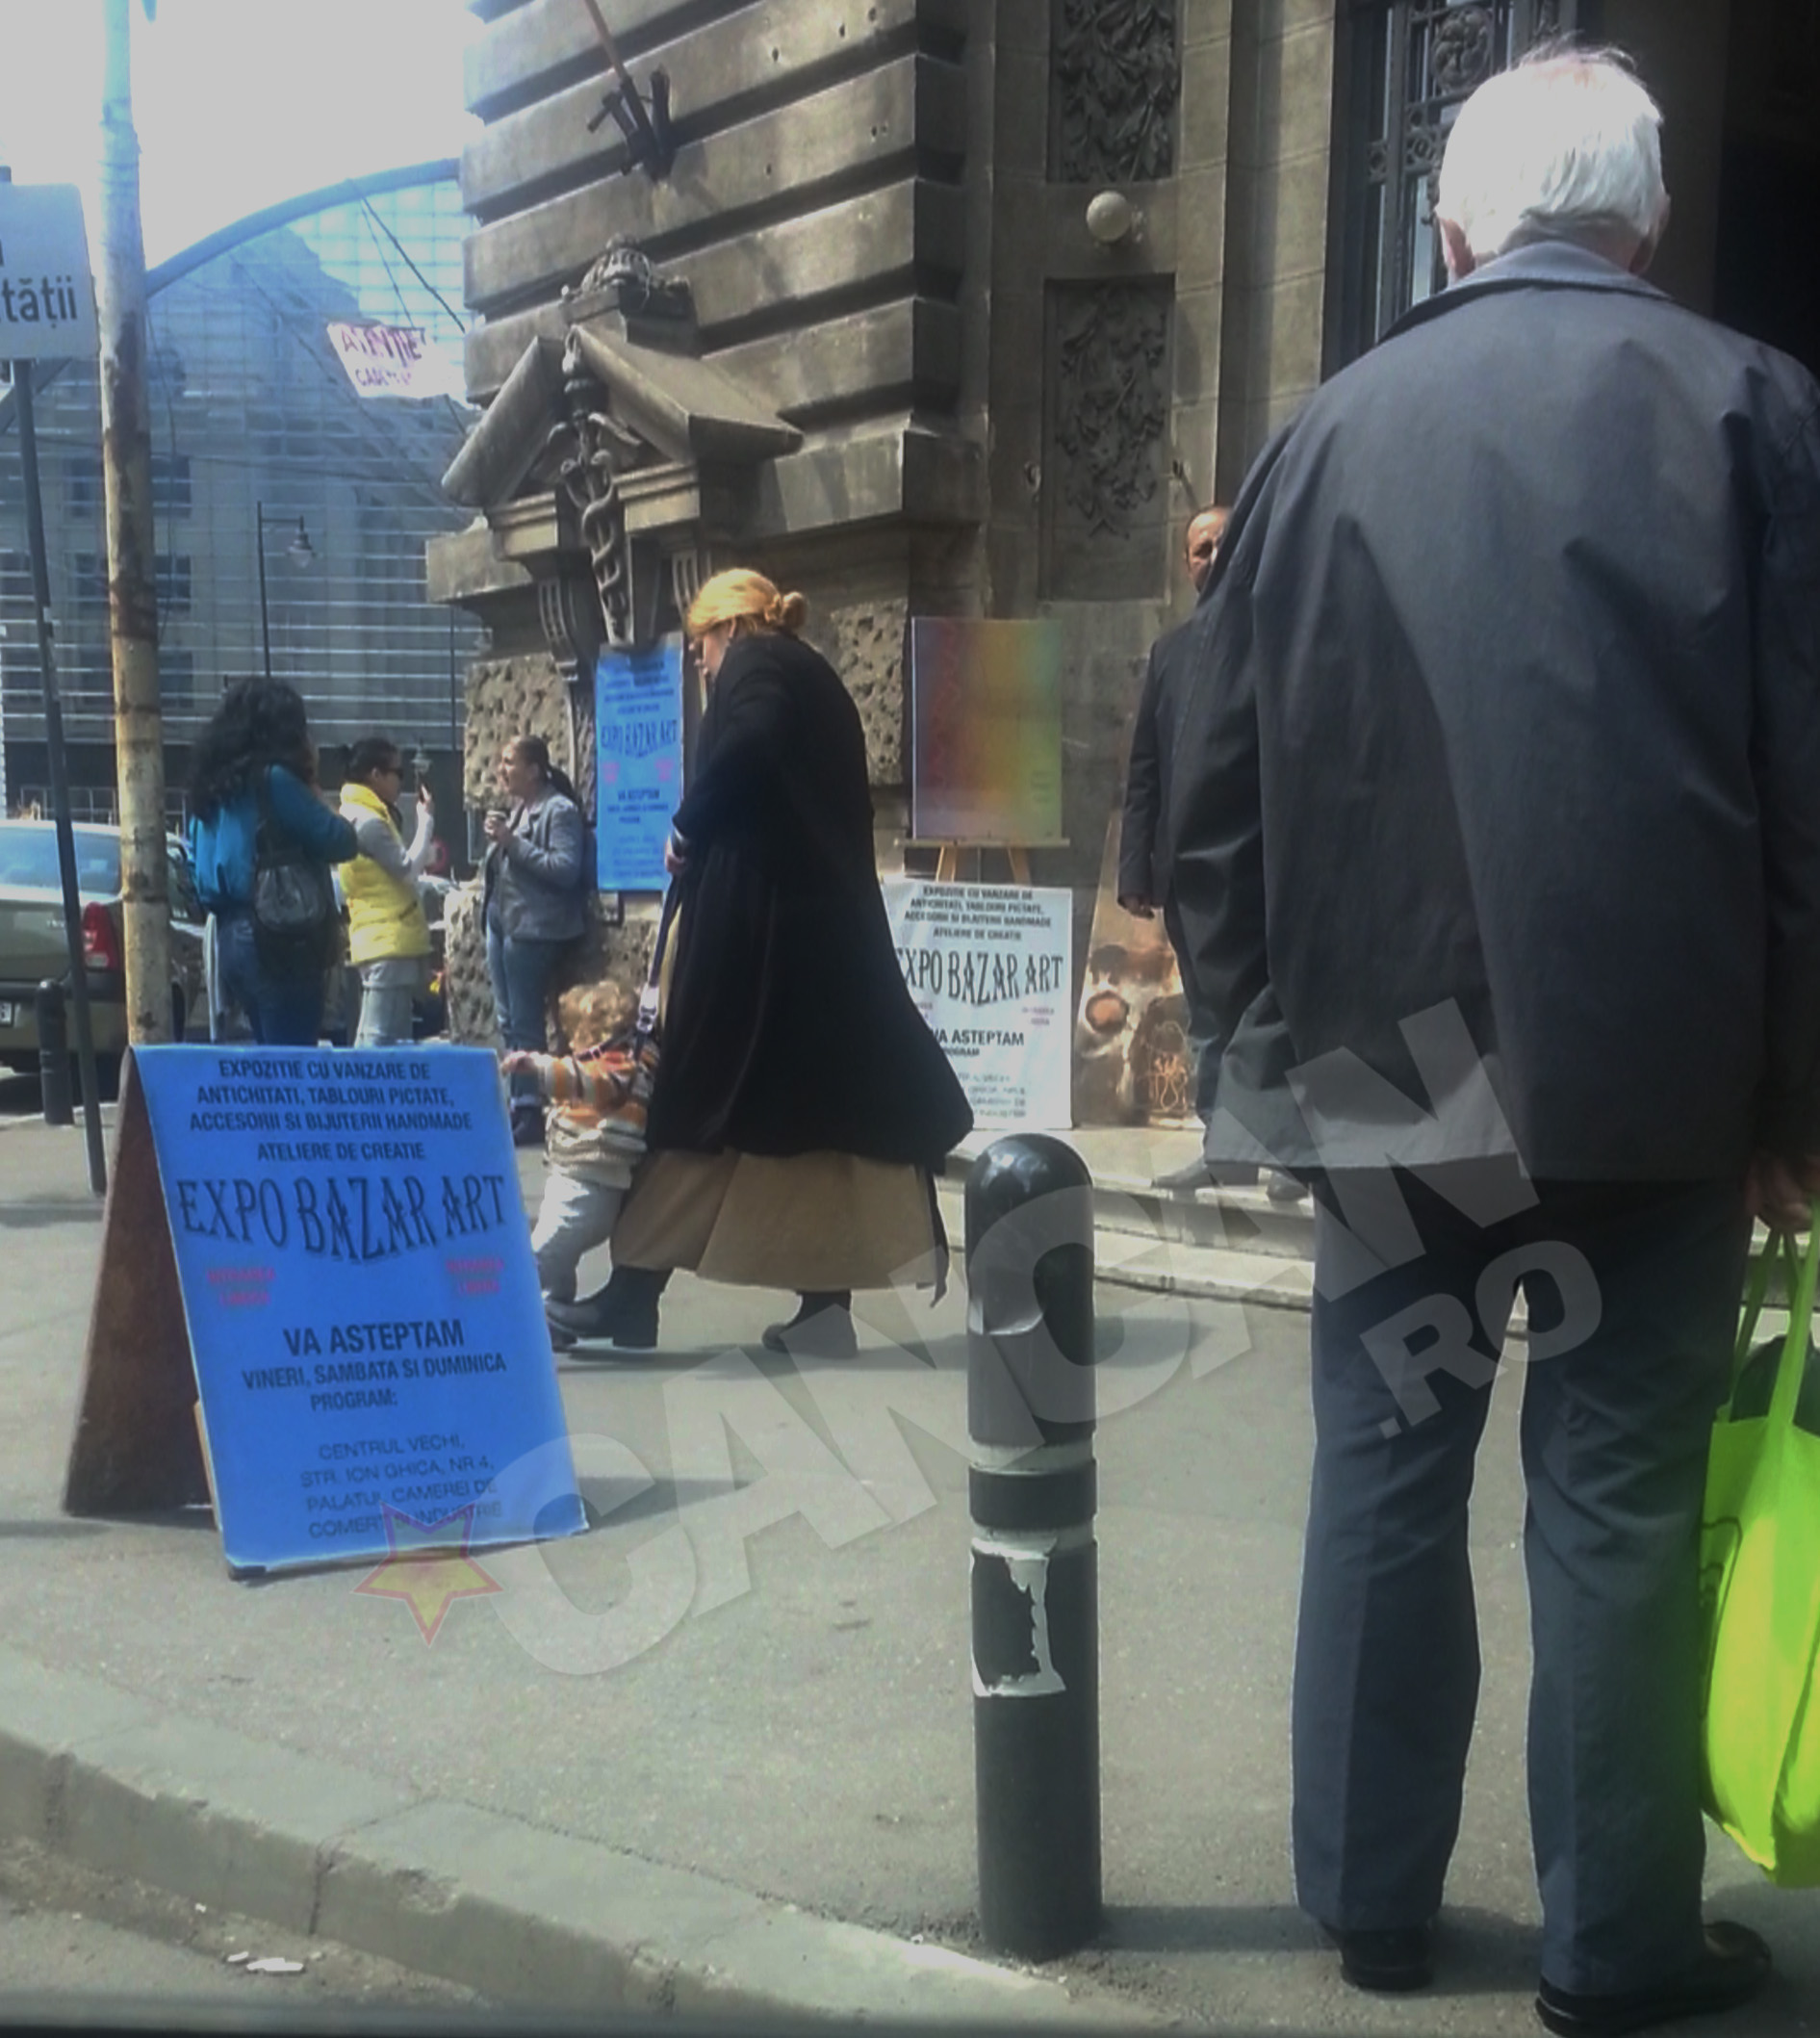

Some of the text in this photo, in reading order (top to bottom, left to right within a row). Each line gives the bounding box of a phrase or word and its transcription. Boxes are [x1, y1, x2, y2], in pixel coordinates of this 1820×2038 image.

[0, 274, 77, 329] tății
[948, 950, 1020, 1007] BAZAR
[1024, 953, 1064, 995] ART
[951, 1029, 1025, 1046] ASTEPTAM
[218, 1060, 430, 1080] EXPOZITIE CU VANZARE DE
[196, 1086, 455, 1107] ANTICHITATI, TABLOURI PICTATE,
[190, 1111, 473, 1131] ACCESORII SI BIJUTERII HANDMADE
[257, 1141, 426, 1162] ATELIERE DE CREATIE
[176, 1174, 505, 1264] EXPO BAZAR ART
[283, 1319, 465, 1357] VA ASTEPTAM
[242, 1352, 507, 1391] VINERI, SAMBATA SI DUMINICA
[310, 1388, 398, 1411] PROGRAM:
[318, 1432, 465, 1461] CENTRUL VECHI,
[346, 1465, 379, 1483] ION
[384, 1458, 446, 1480] GHICA,
[306, 1478, 499, 1513] PALATUL CAMEREI DE
